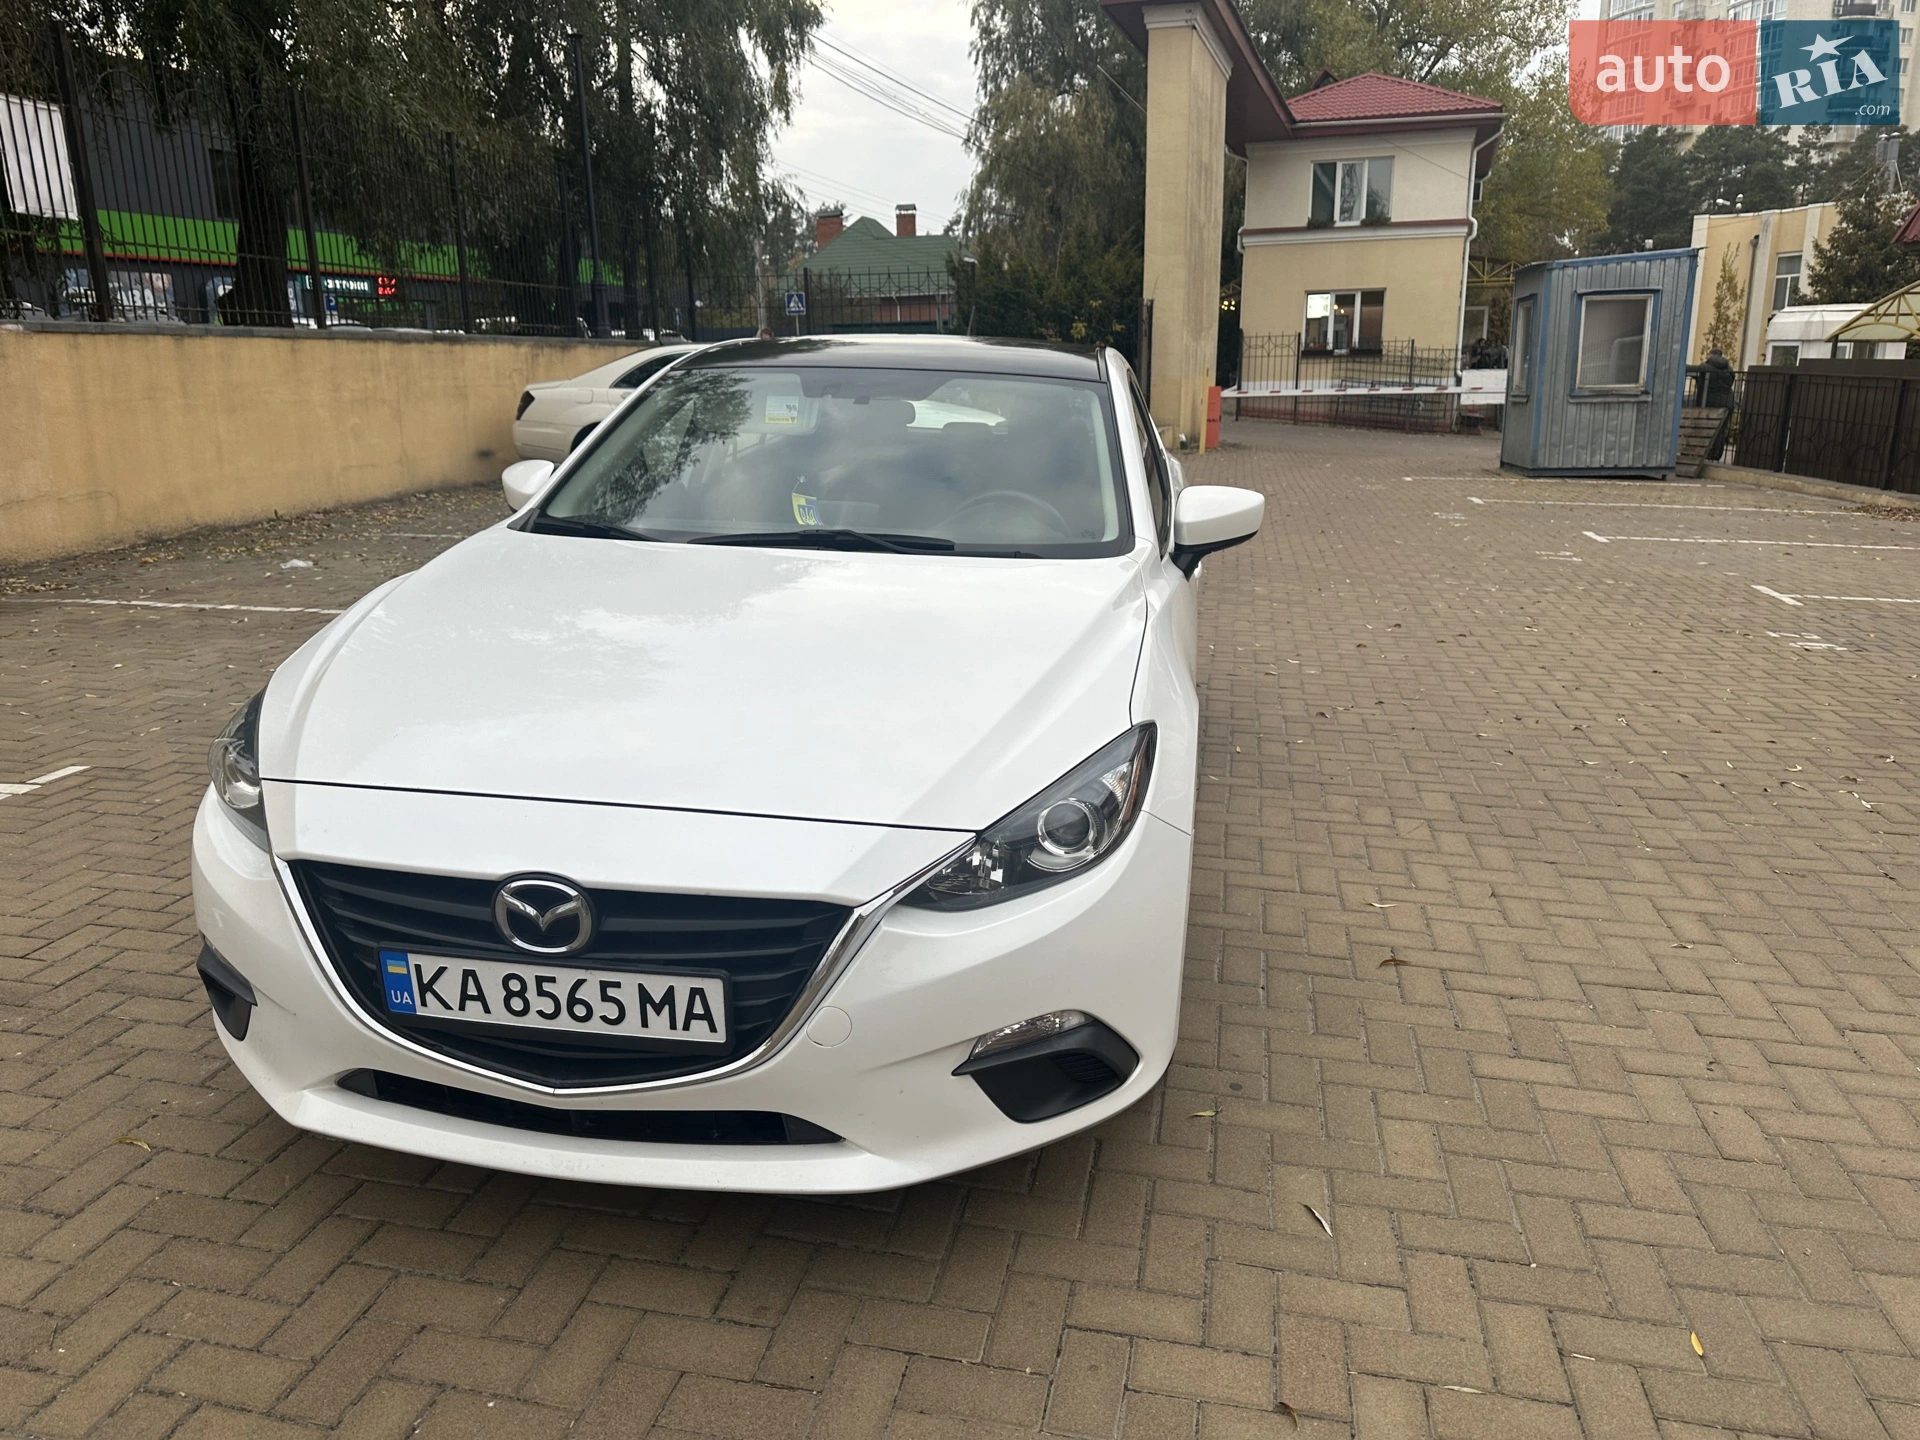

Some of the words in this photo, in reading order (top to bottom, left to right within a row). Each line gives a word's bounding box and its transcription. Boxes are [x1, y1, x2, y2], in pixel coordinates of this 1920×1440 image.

[392, 990, 413, 1005] UA
[414, 963, 491, 1014] KA
[502, 973, 626, 1025] 8565
[638, 982, 718, 1033] MA
